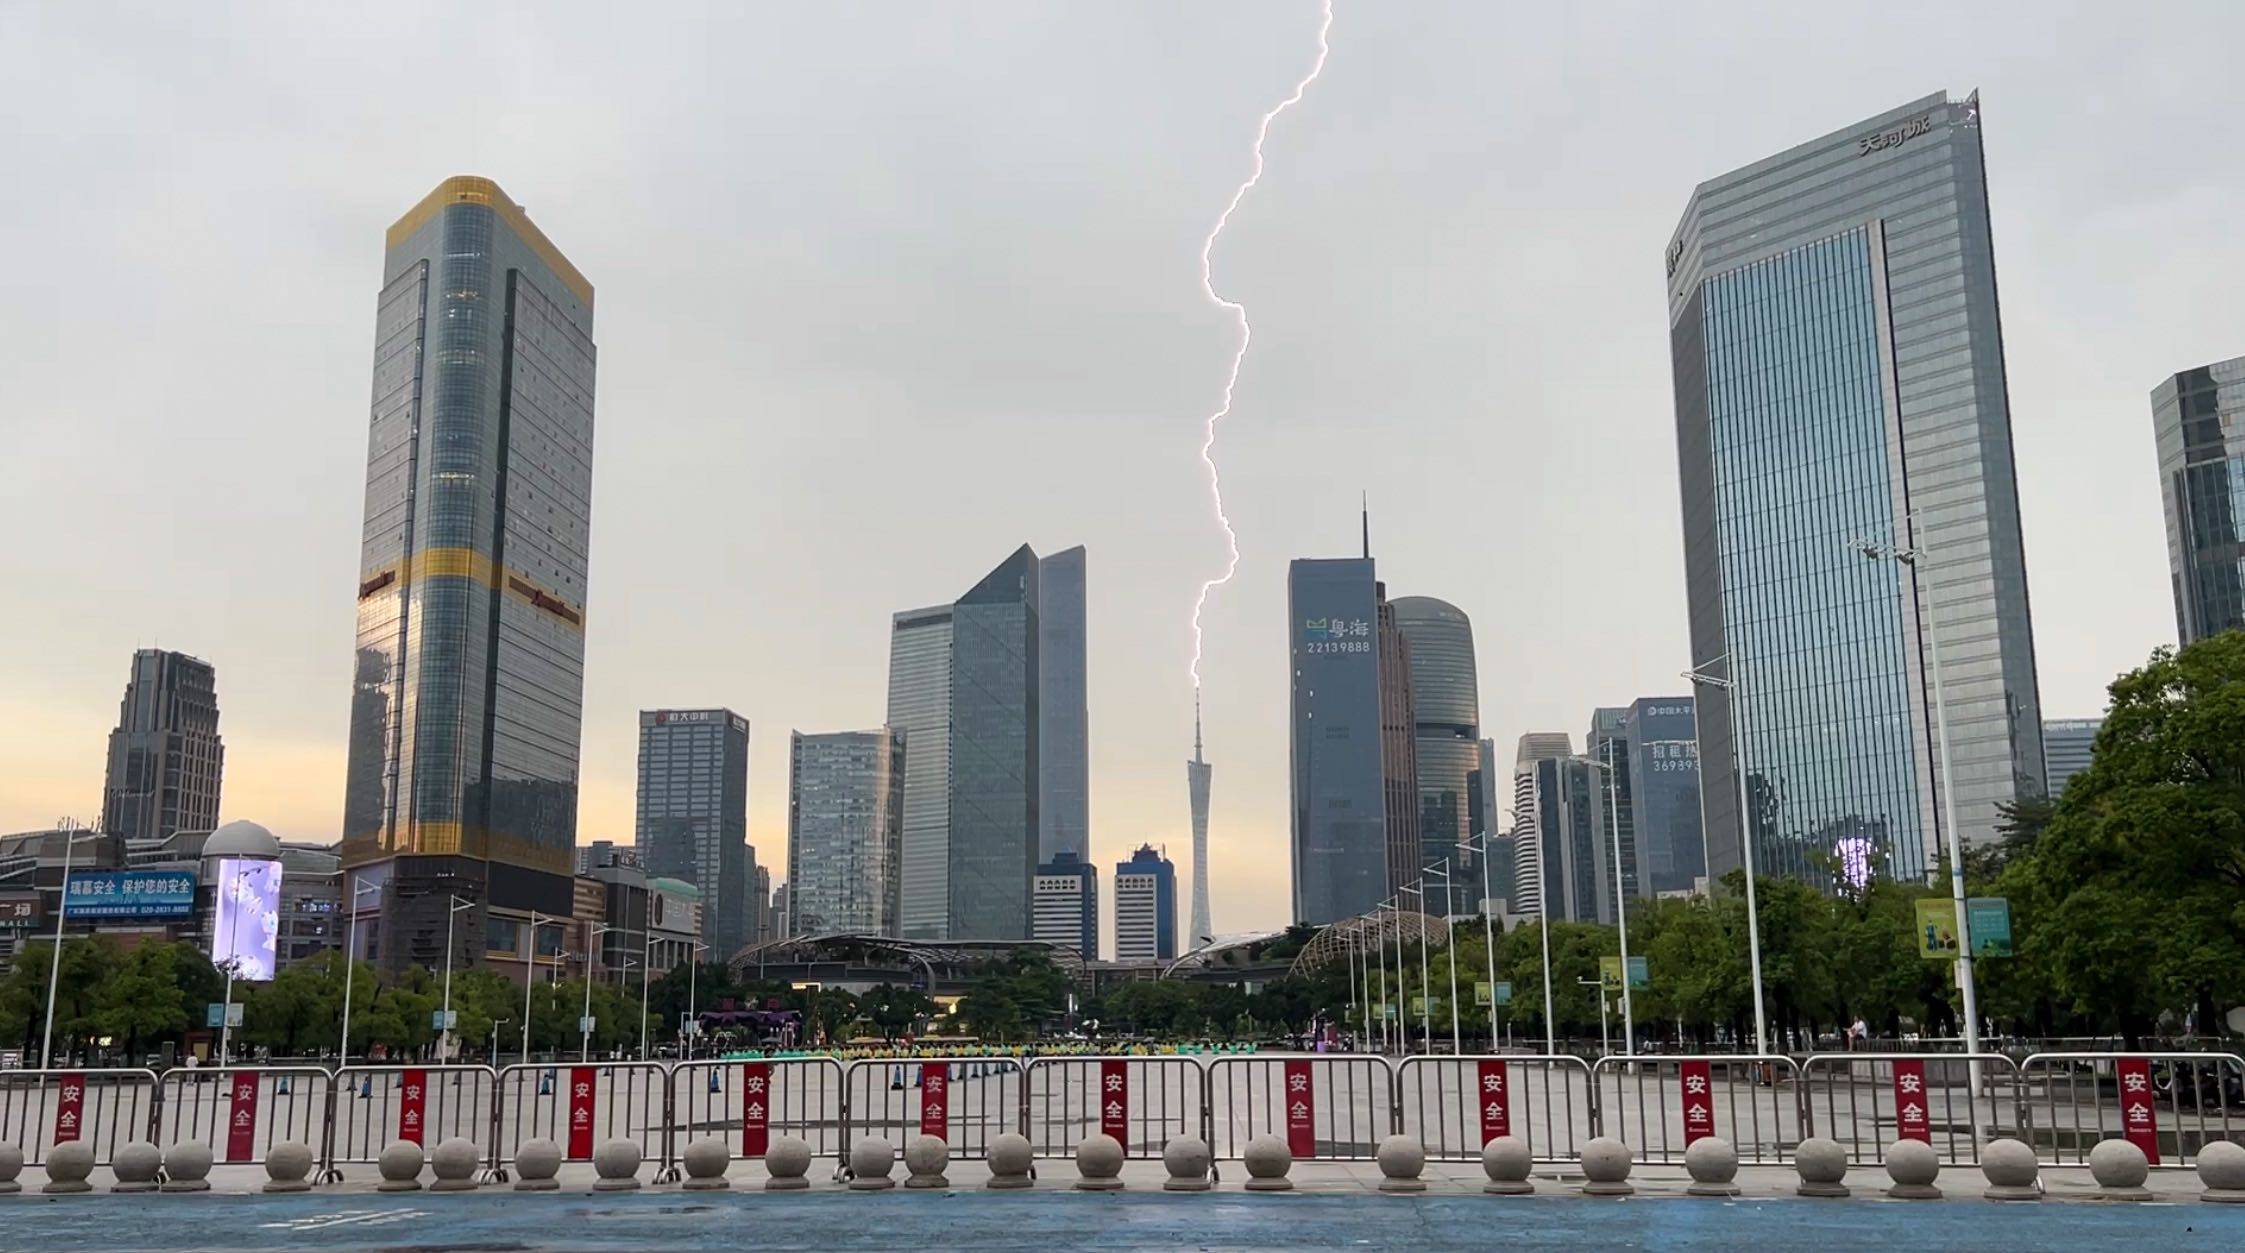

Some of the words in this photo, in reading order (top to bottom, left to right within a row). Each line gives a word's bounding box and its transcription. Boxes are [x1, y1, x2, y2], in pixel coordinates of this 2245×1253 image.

[1859, 115, 1931, 157] 天河城
[1307, 642, 1370, 653] 22139888
[1329, 619, 1369, 638] 粤海
[122, 878, 190, 894] 保护您的安全
[62, 1084, 80, 1128] 安全
[235, 1083, 252, 1127] 安全
[404, 1084, 420, 1125] 安全
[574, 1081, 590, 1124] 安全
[747, 1076, 764, 1120] 安全
[925, 1074, 943, 1120] 安全
[1105, 1073, 1123, 1119] 安全
[1290, 1073, 1308, 1120] 安全
[1484, 1074, 1504, 1121] 安全
[1686, 1074, 1708, 1123] 安全
[1899, 1073, 1924, 1122] 安全
[2124, 1072, 2150, 1122] 安全
